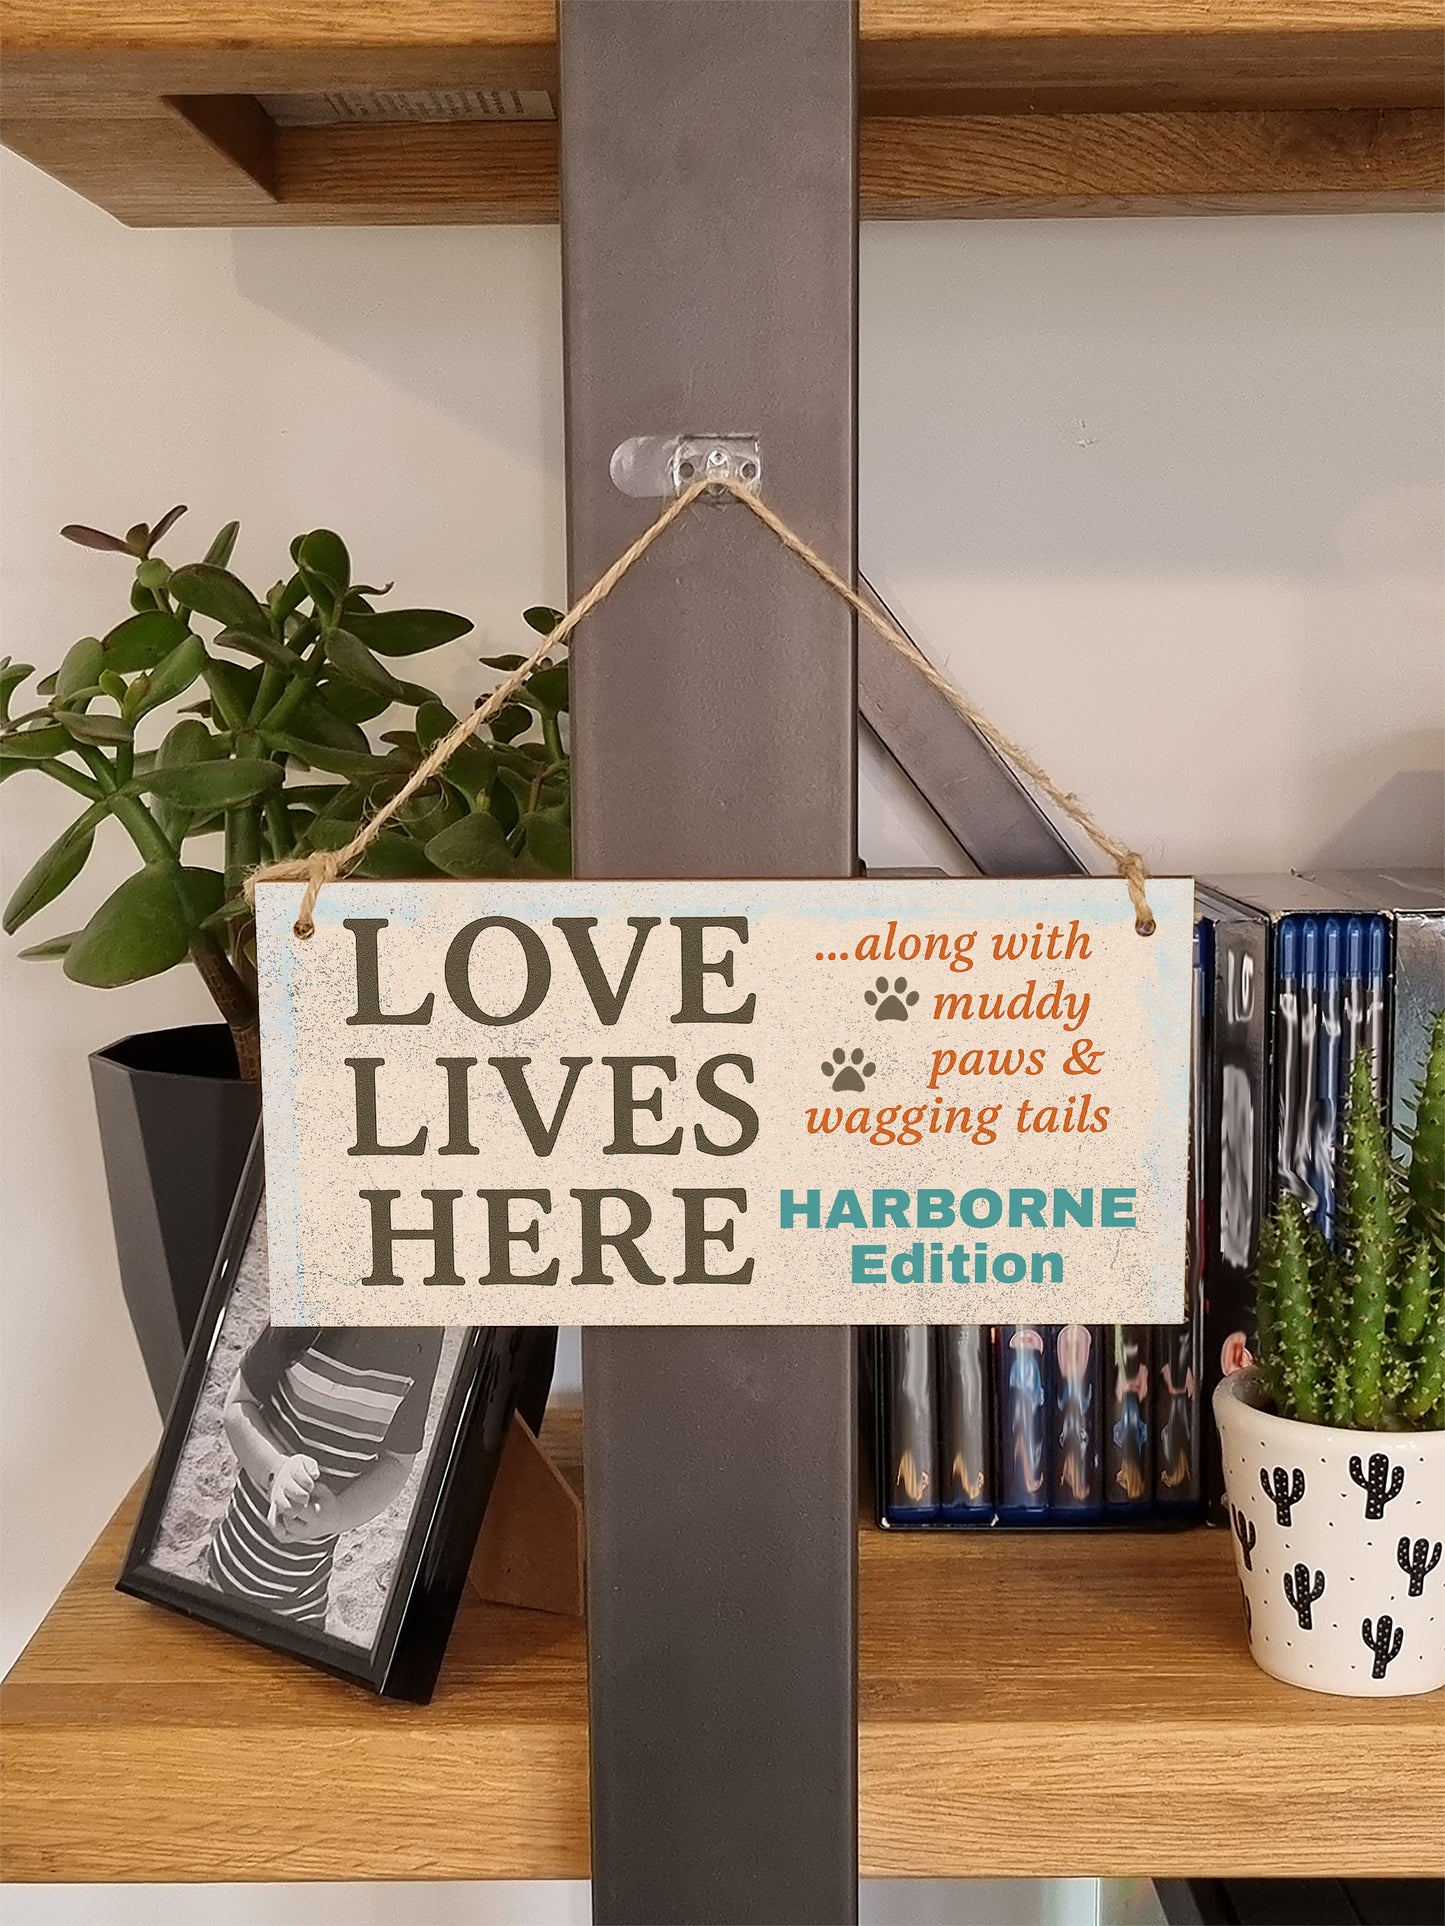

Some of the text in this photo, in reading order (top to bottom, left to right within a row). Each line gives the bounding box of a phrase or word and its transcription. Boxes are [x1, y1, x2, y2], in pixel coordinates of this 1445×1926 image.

[343, 916, 756, 1026] LOVE
[816, 920, 1091, 972] ...along with
[934, 980, 1090, 1032] muddy
[927, 1039, 1104, 1089] paws &
[344, 1054, 758, 1157] LIVES
[806, 1094, 1110, 1146] wagging tails
[781, 1189, 1135, 1228] HARBORNE
[359, 1188, 754, 1286] HERE
[853, 1243, 1062, 1283] Edition
